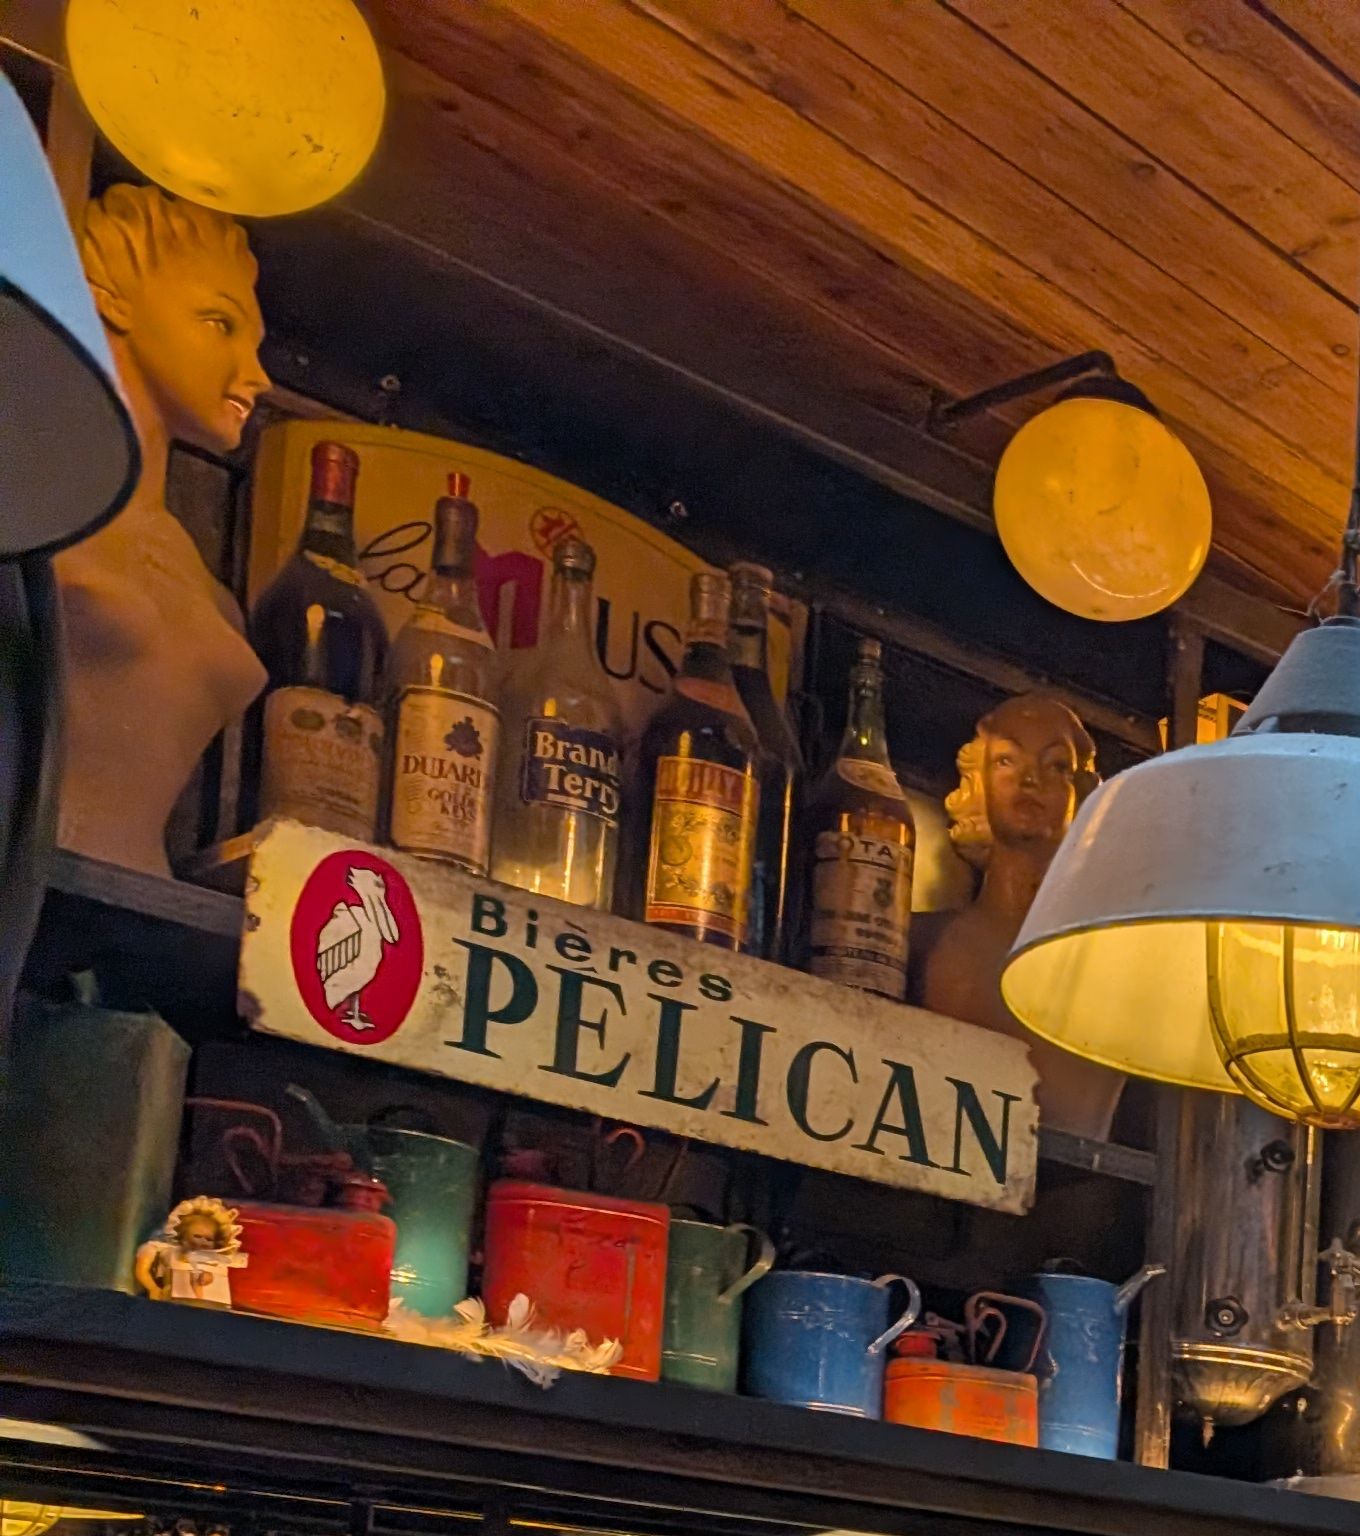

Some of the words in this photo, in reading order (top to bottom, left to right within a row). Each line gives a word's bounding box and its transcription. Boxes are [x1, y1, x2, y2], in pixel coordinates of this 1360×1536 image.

[402, 755, 481, 788] DUJAR
[471, 893, 734, 1002] Bières
[443, 936, 1023, 1186] PÉLICAN
